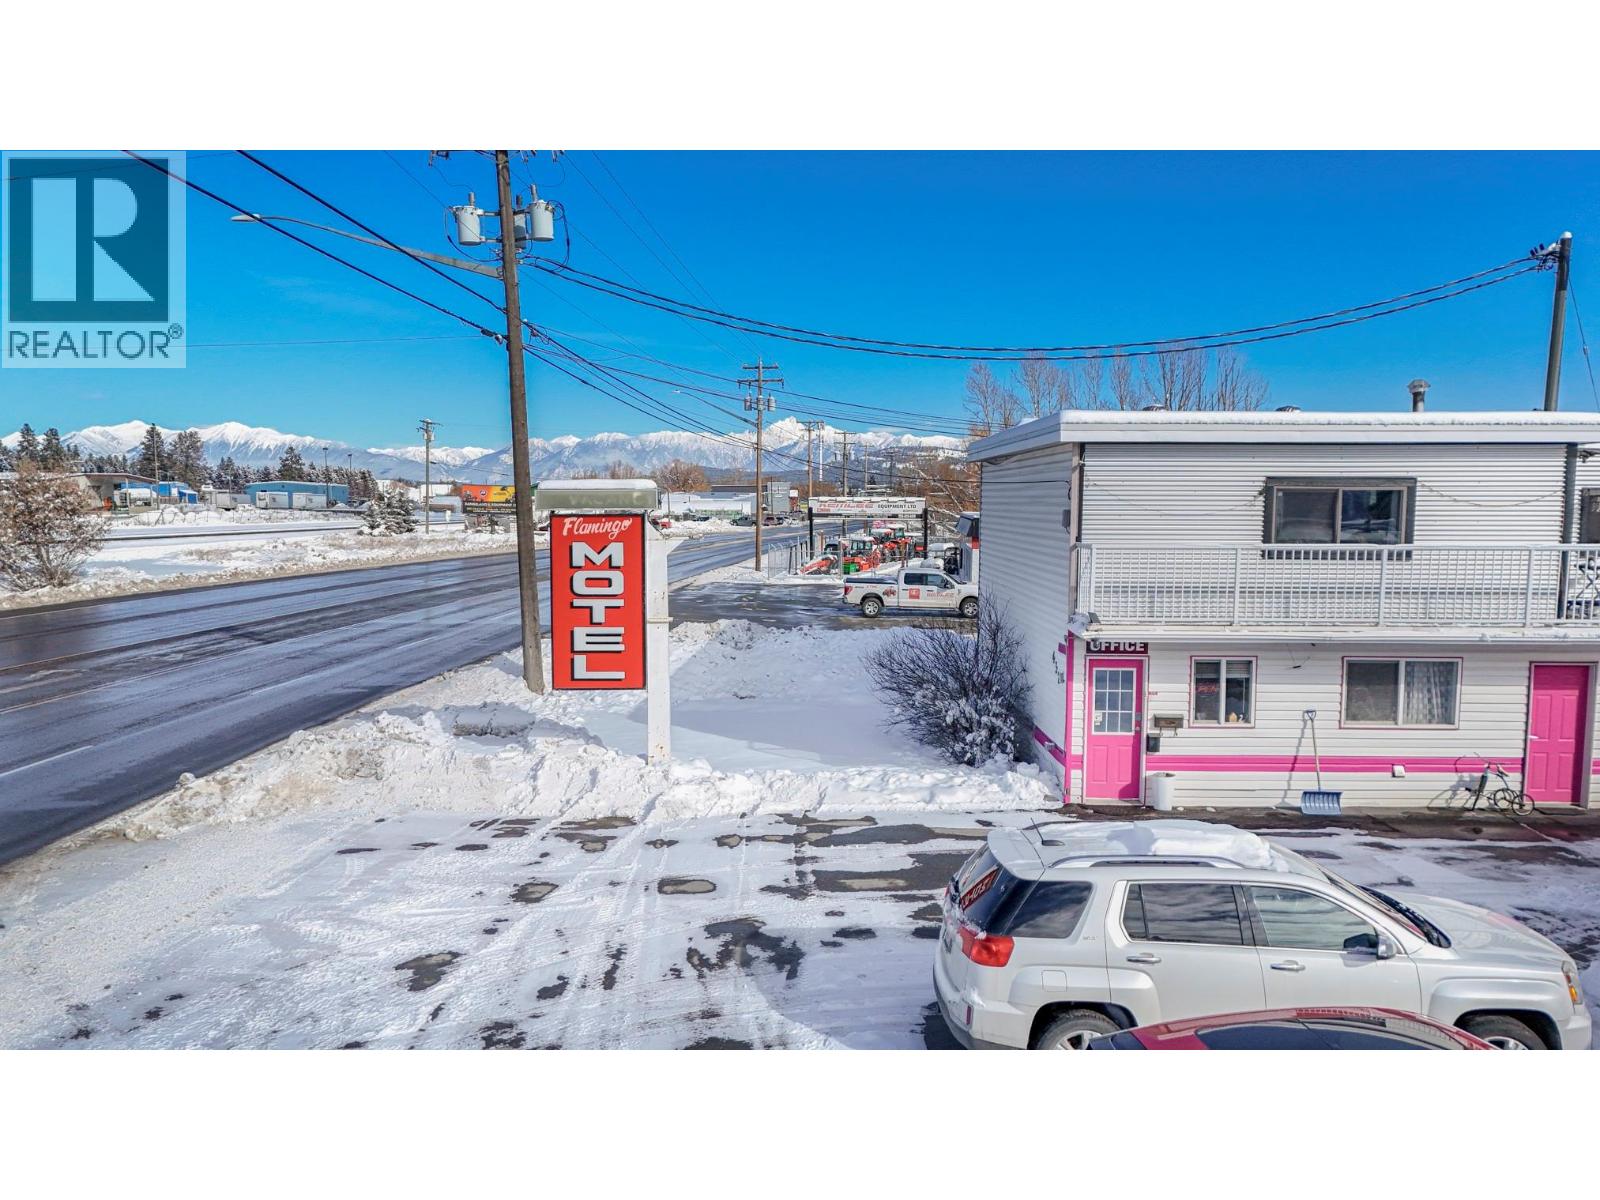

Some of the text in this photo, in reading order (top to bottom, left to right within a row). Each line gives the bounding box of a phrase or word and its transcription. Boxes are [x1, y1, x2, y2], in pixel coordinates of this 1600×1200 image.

[562, 517, 633, 540] Flamingo
[571, 541, 626, 680] MOTEL
[1089, 641, 1145, 652] OFFICE
